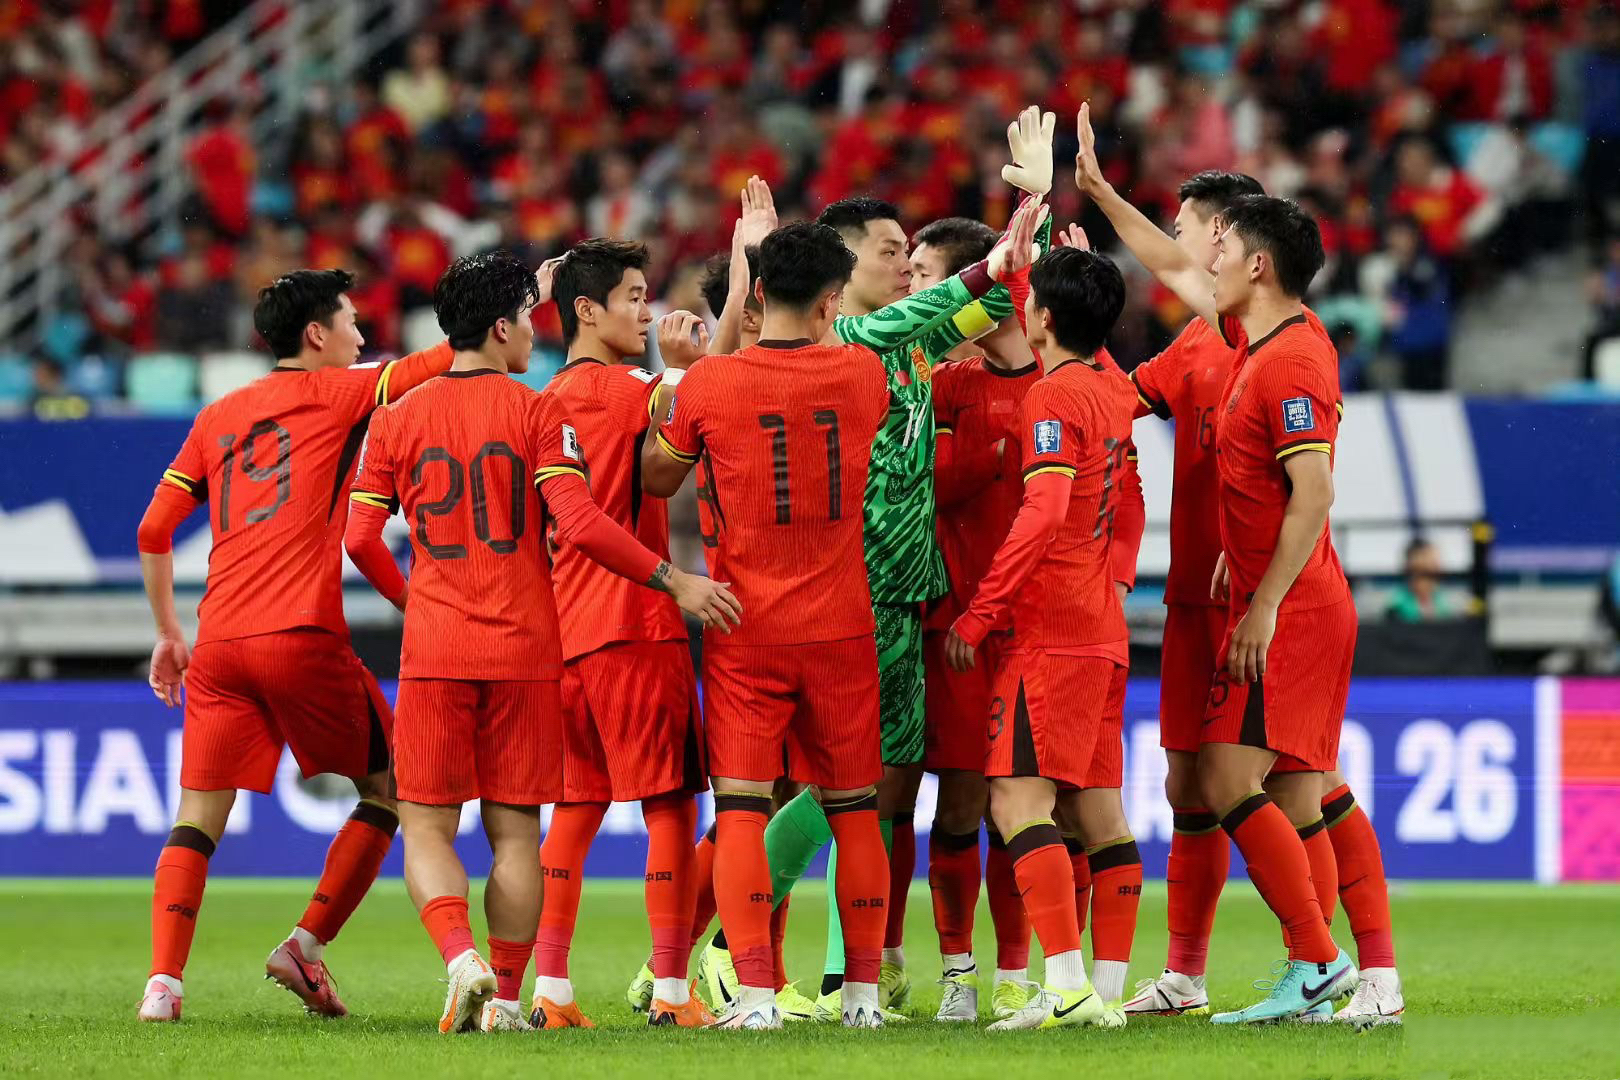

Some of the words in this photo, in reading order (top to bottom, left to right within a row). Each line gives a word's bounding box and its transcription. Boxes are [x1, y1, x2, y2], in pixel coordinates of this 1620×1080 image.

[218, 419, 291, 532] 19
[411, 440, 526, 560] 20
[758, 409, 841, 525] 11
[1394, 718, 1518, 845] 26
[166, 903, 197, 920] 中国
[852, 898, 884, 908] 中国
